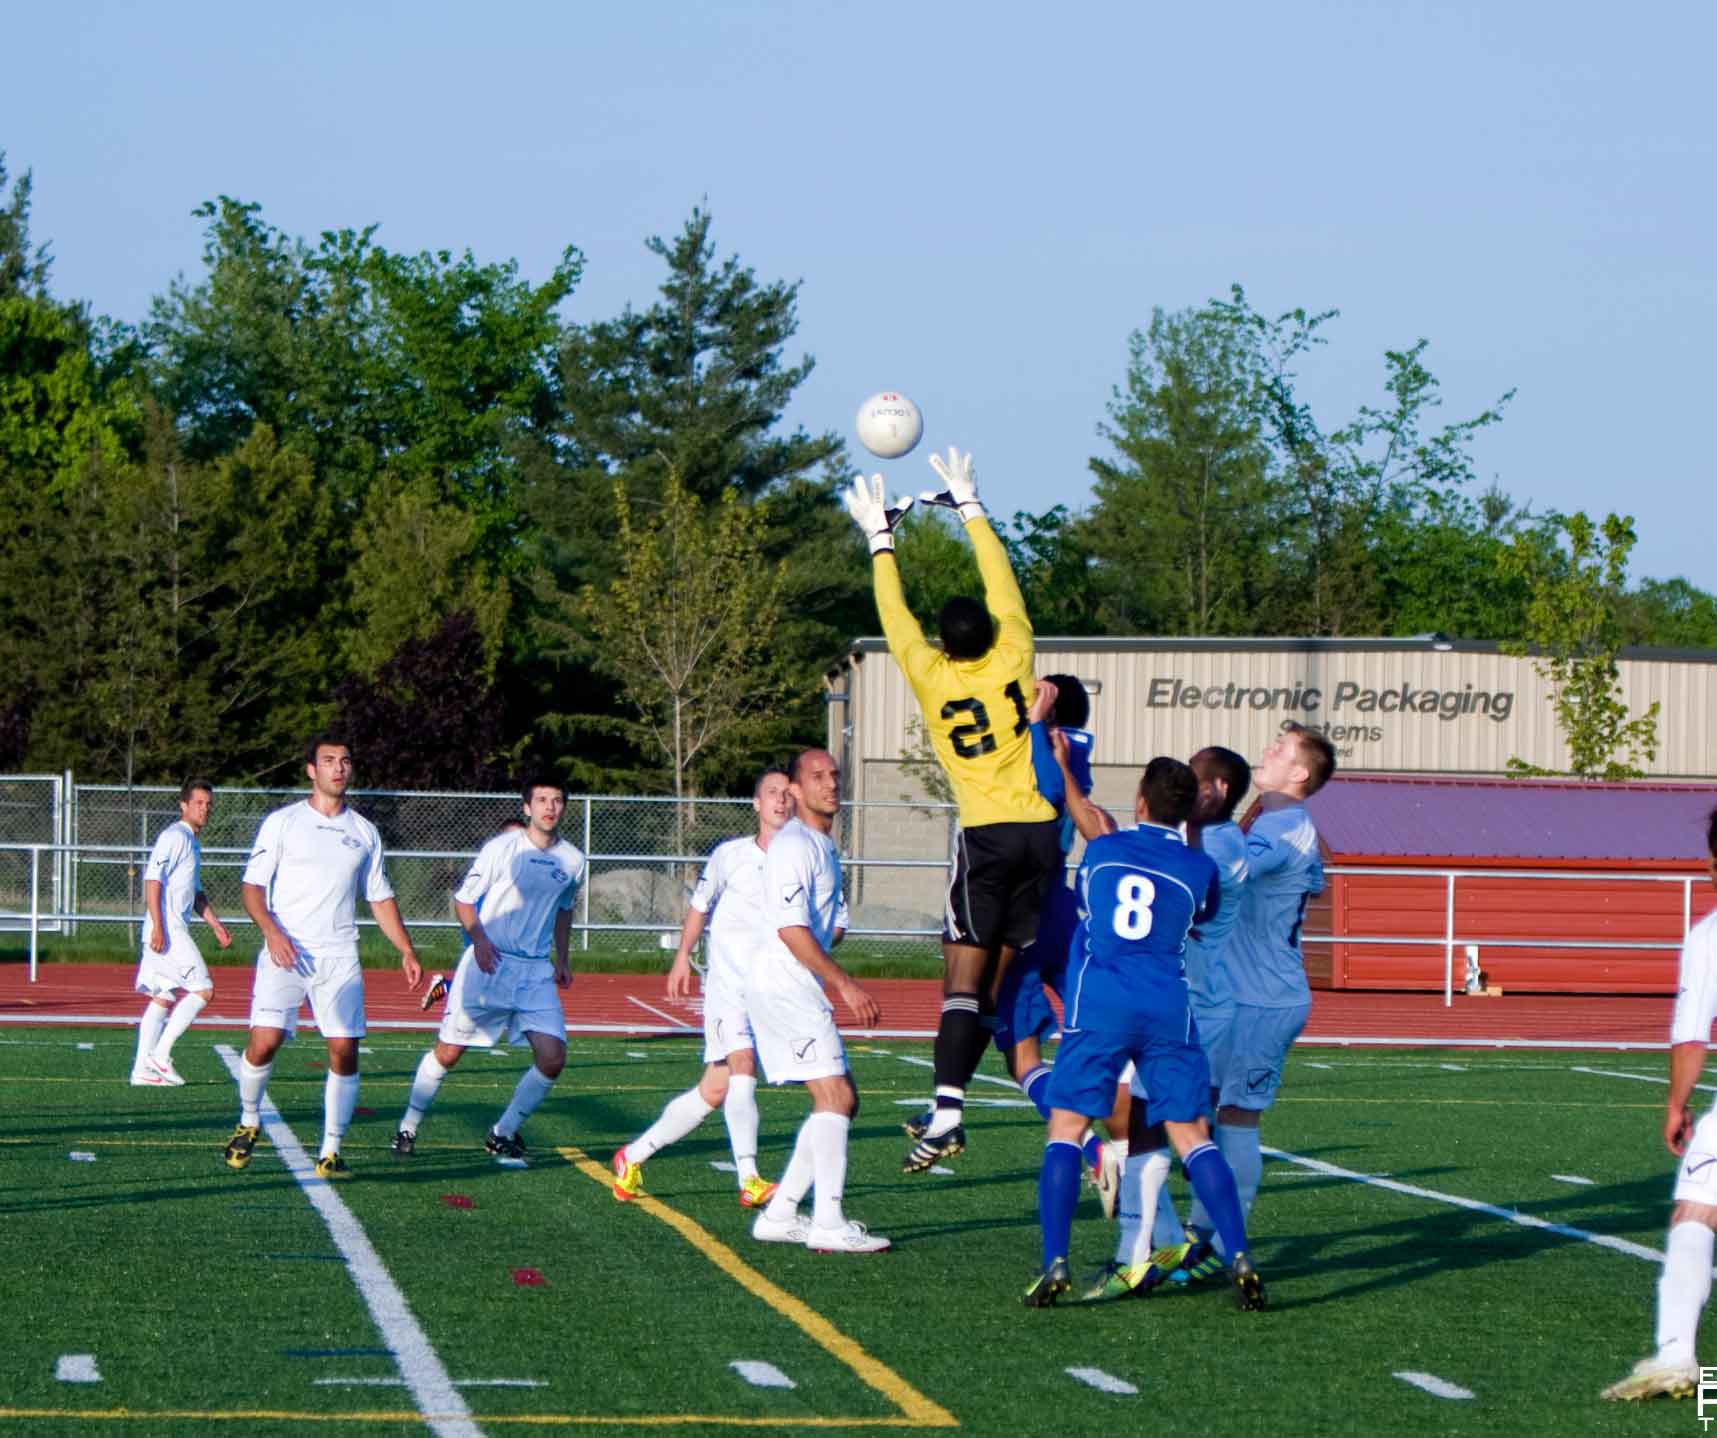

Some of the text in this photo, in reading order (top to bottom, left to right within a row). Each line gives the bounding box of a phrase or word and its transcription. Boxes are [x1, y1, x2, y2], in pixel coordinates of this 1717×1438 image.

[941, 679, 1030, 760] 21
[1146, 677, 1515, 722] Electronic Packaging
[1112, 874, 1156, 941] 8
